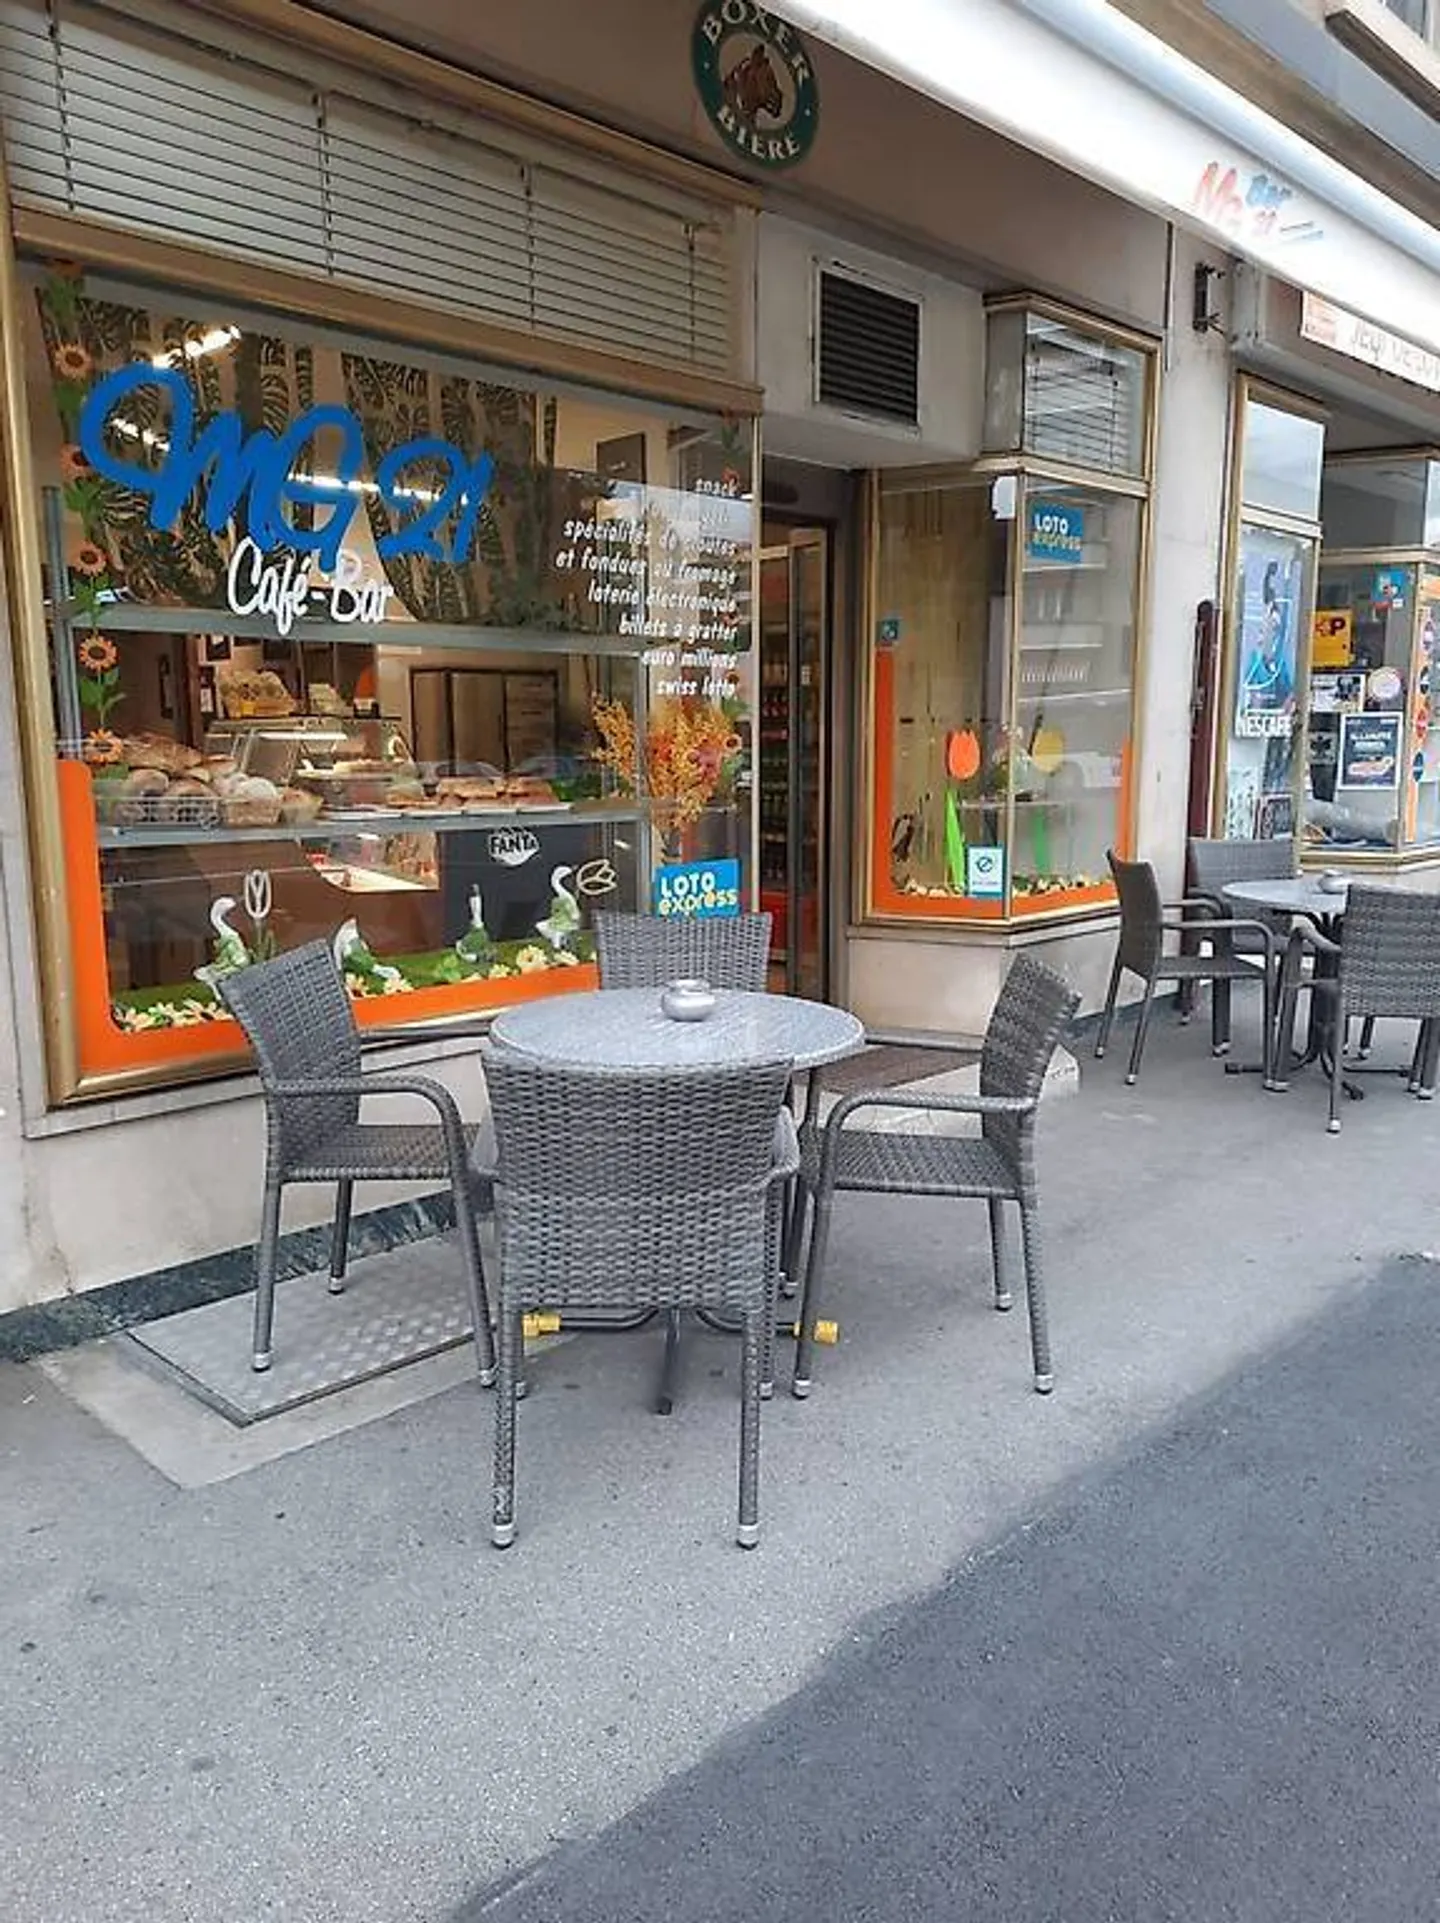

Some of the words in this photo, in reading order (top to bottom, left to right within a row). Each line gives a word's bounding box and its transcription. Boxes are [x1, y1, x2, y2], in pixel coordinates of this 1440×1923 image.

[701, 0, 810, 89] BOXER
[695, 477, 738, 498] snack
[563, 517, 651, 547] spécialités
[659, 526, 678, 549] de
[1034, 513, 1069, 535] LOTO
[555, 550, 574, 568] et
[580, 546, 649, 576] fondues
[654, 560, 674, 579] au
[676, 561, 738, 591] fromage
[588, 580, 646, 608] loterie
[646, 587, 738, 618] électronique
[618, 611, 668, 638] billets
[687, 623, 738, 645] gratter
[641, 651, 676, 668] euro
[681, 647, 739, 670] millions
[655, 678, 697, 697] swiss
[489, 832, 538, 855] FANTA
[660, 870, 716, 898] LOTO
[658, 888, 738, 916] express
